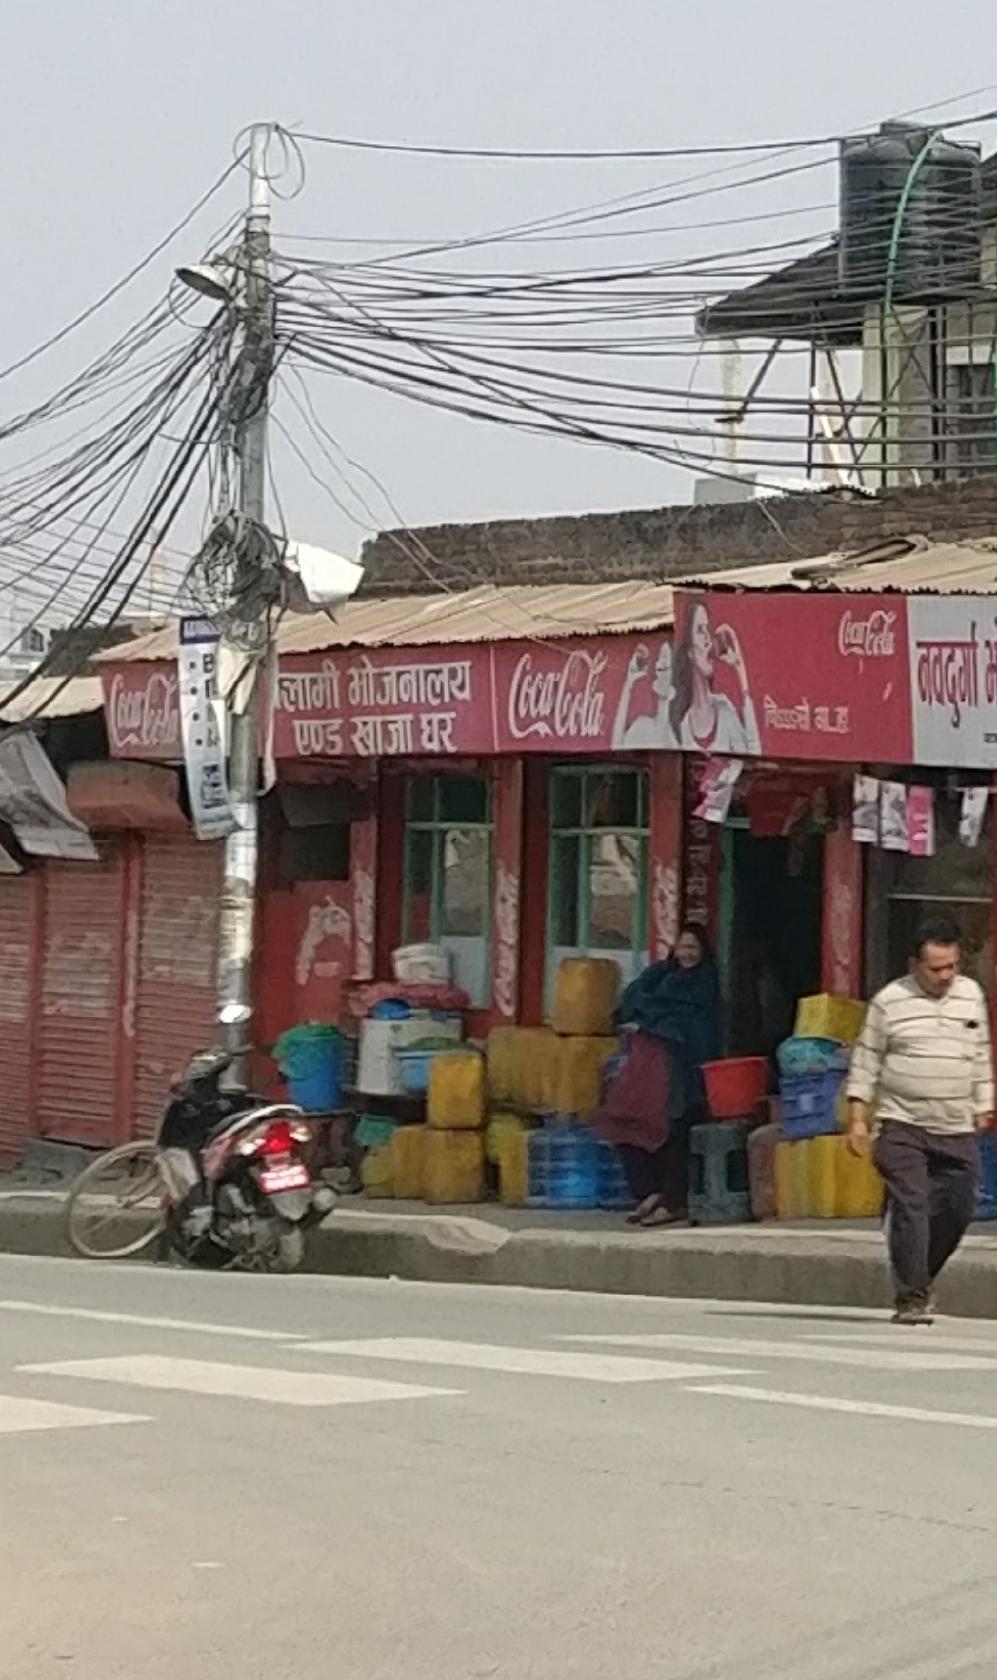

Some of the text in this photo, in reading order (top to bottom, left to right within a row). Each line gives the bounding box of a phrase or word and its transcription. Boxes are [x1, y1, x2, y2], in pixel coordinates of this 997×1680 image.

[347, 654, 472, 706] भोजनालय
[292, 711, 458, 757] एण्ड खाजा घर
